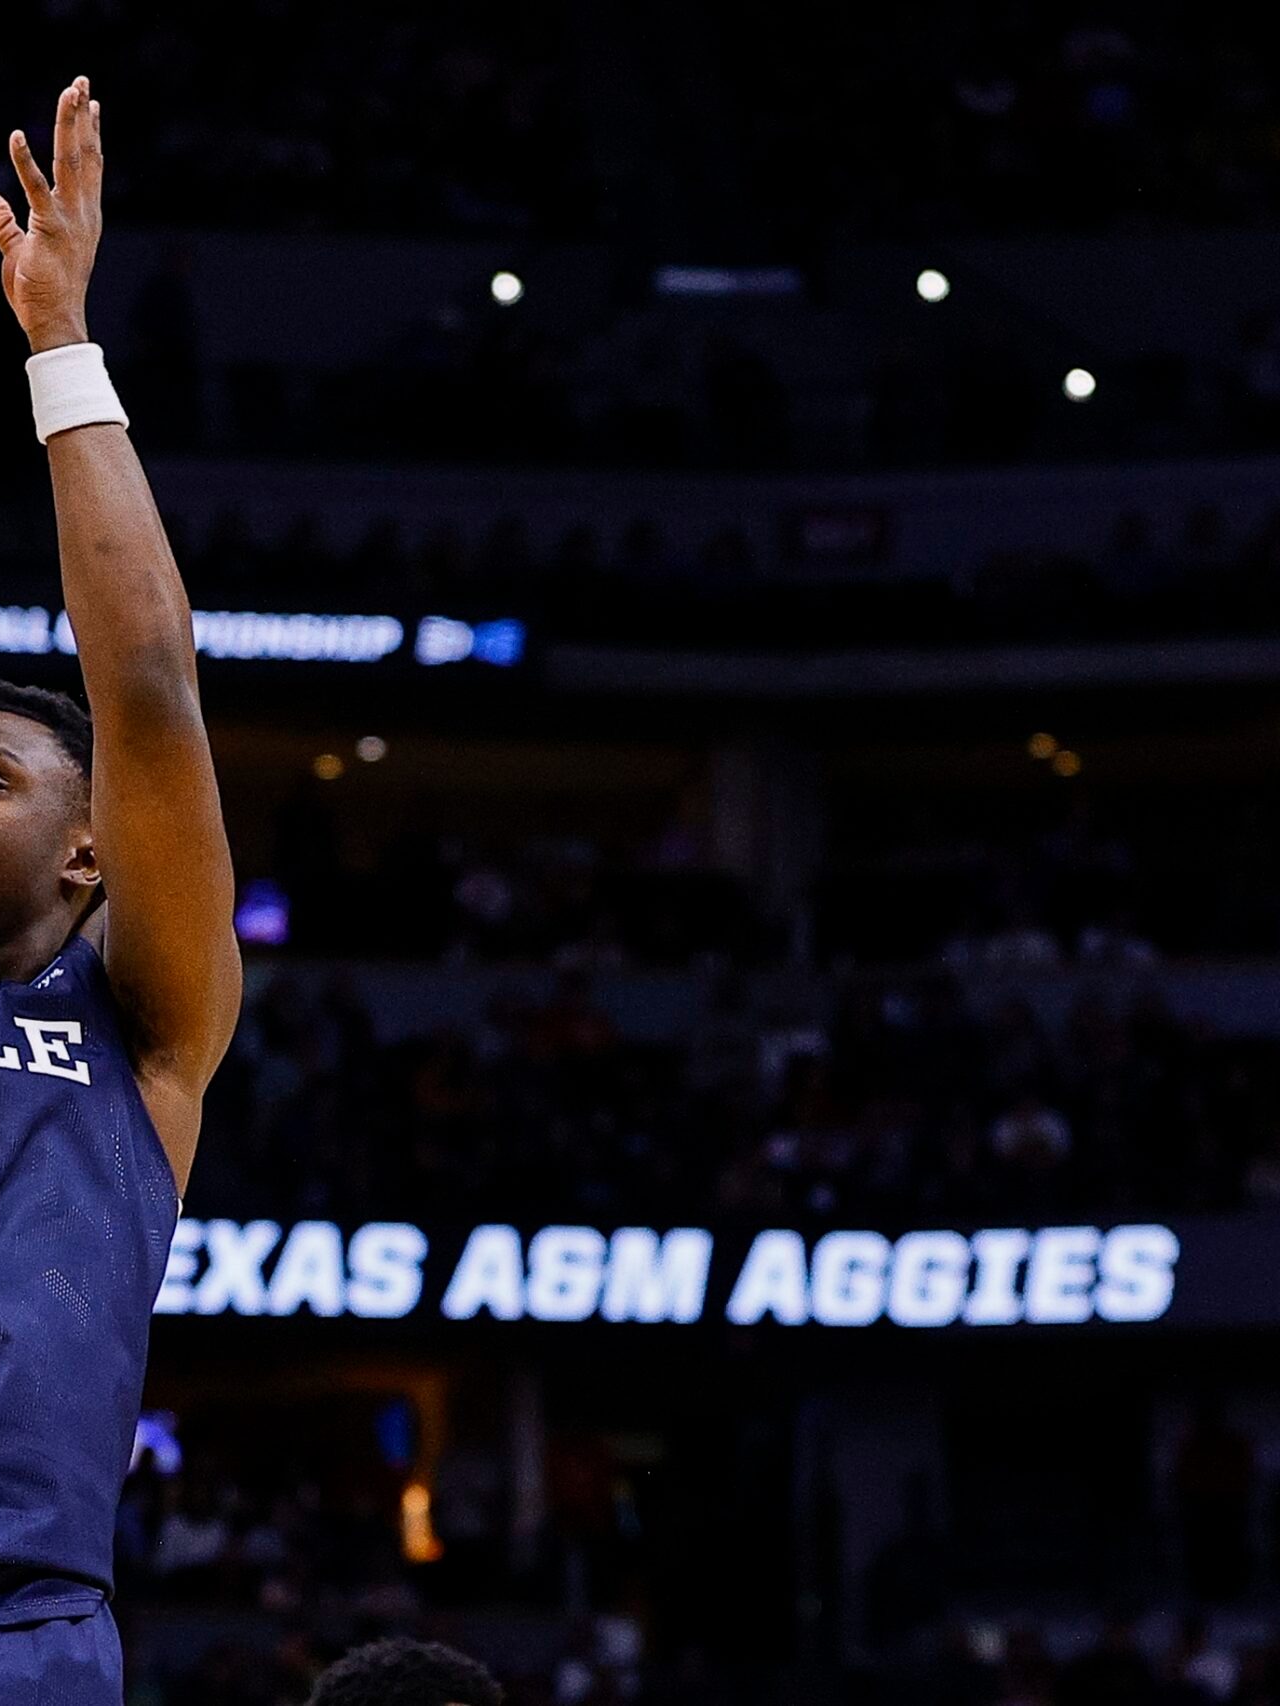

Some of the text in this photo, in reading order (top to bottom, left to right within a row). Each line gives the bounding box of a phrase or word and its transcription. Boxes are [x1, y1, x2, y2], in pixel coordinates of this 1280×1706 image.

[153, 1218, 1180, 1326] EXAS A&M AGGIES
